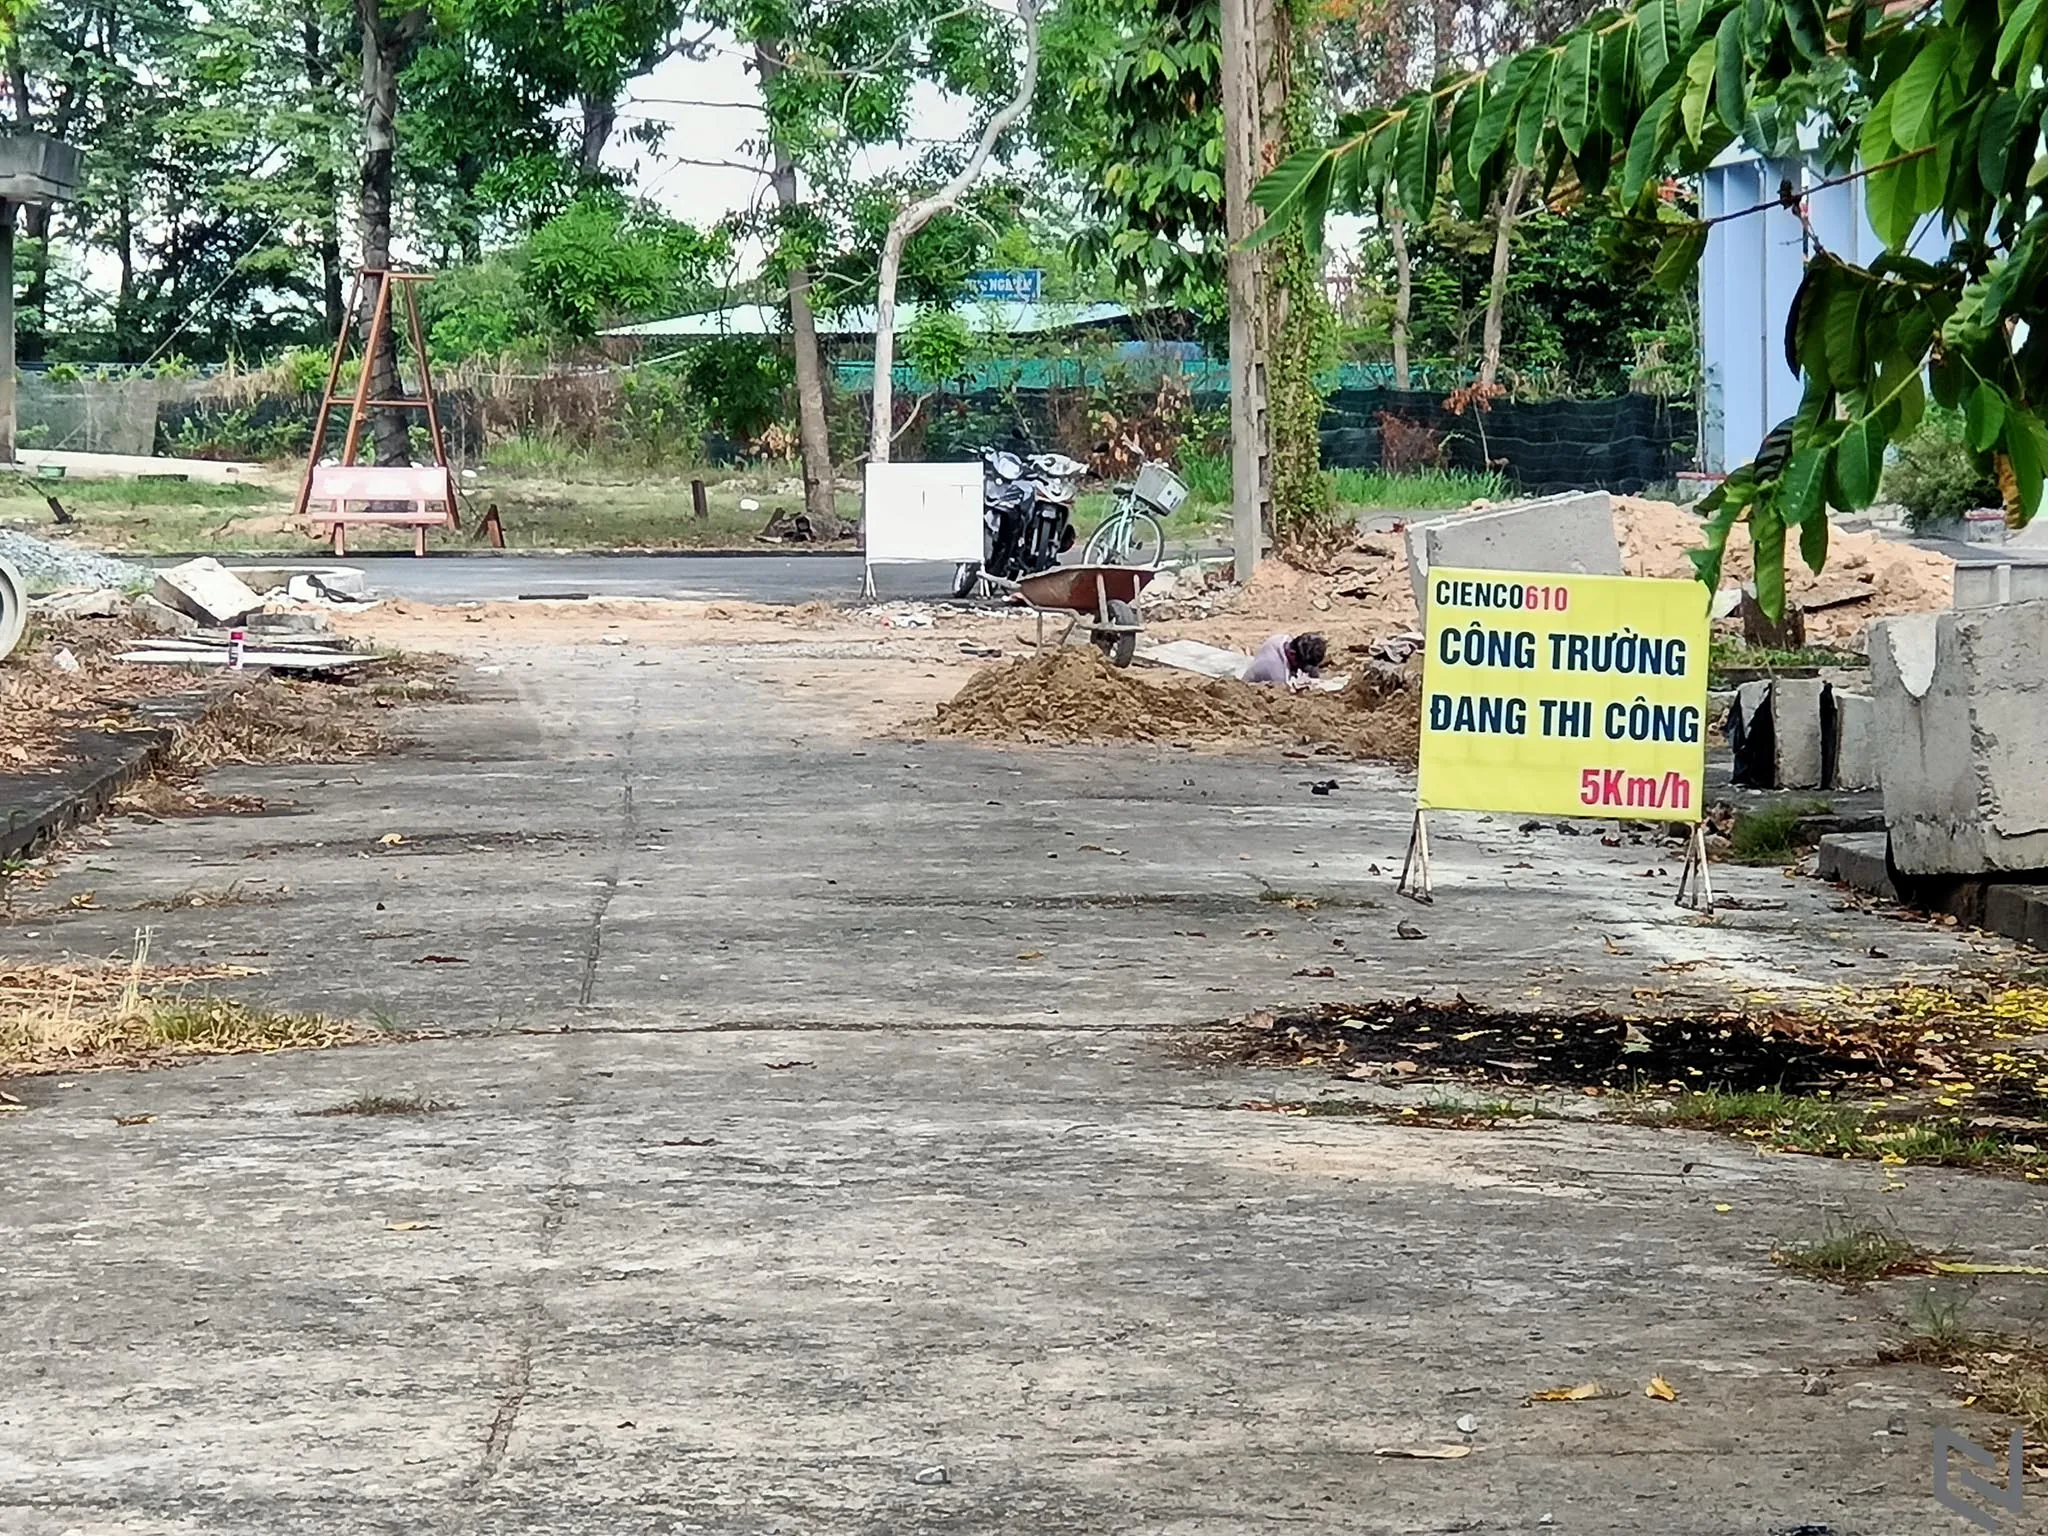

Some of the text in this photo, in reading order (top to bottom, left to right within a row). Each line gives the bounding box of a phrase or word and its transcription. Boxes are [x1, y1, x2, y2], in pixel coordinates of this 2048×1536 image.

[1436, 580, 1568, 611] CIENCO610
[1440, 621, 1687, 676] CÔNG TRƯỜNG
[1430, 694, 1699, 743] ĐANG THI CÔNG
[1580, 769, 1690, 809] 5Km/h
